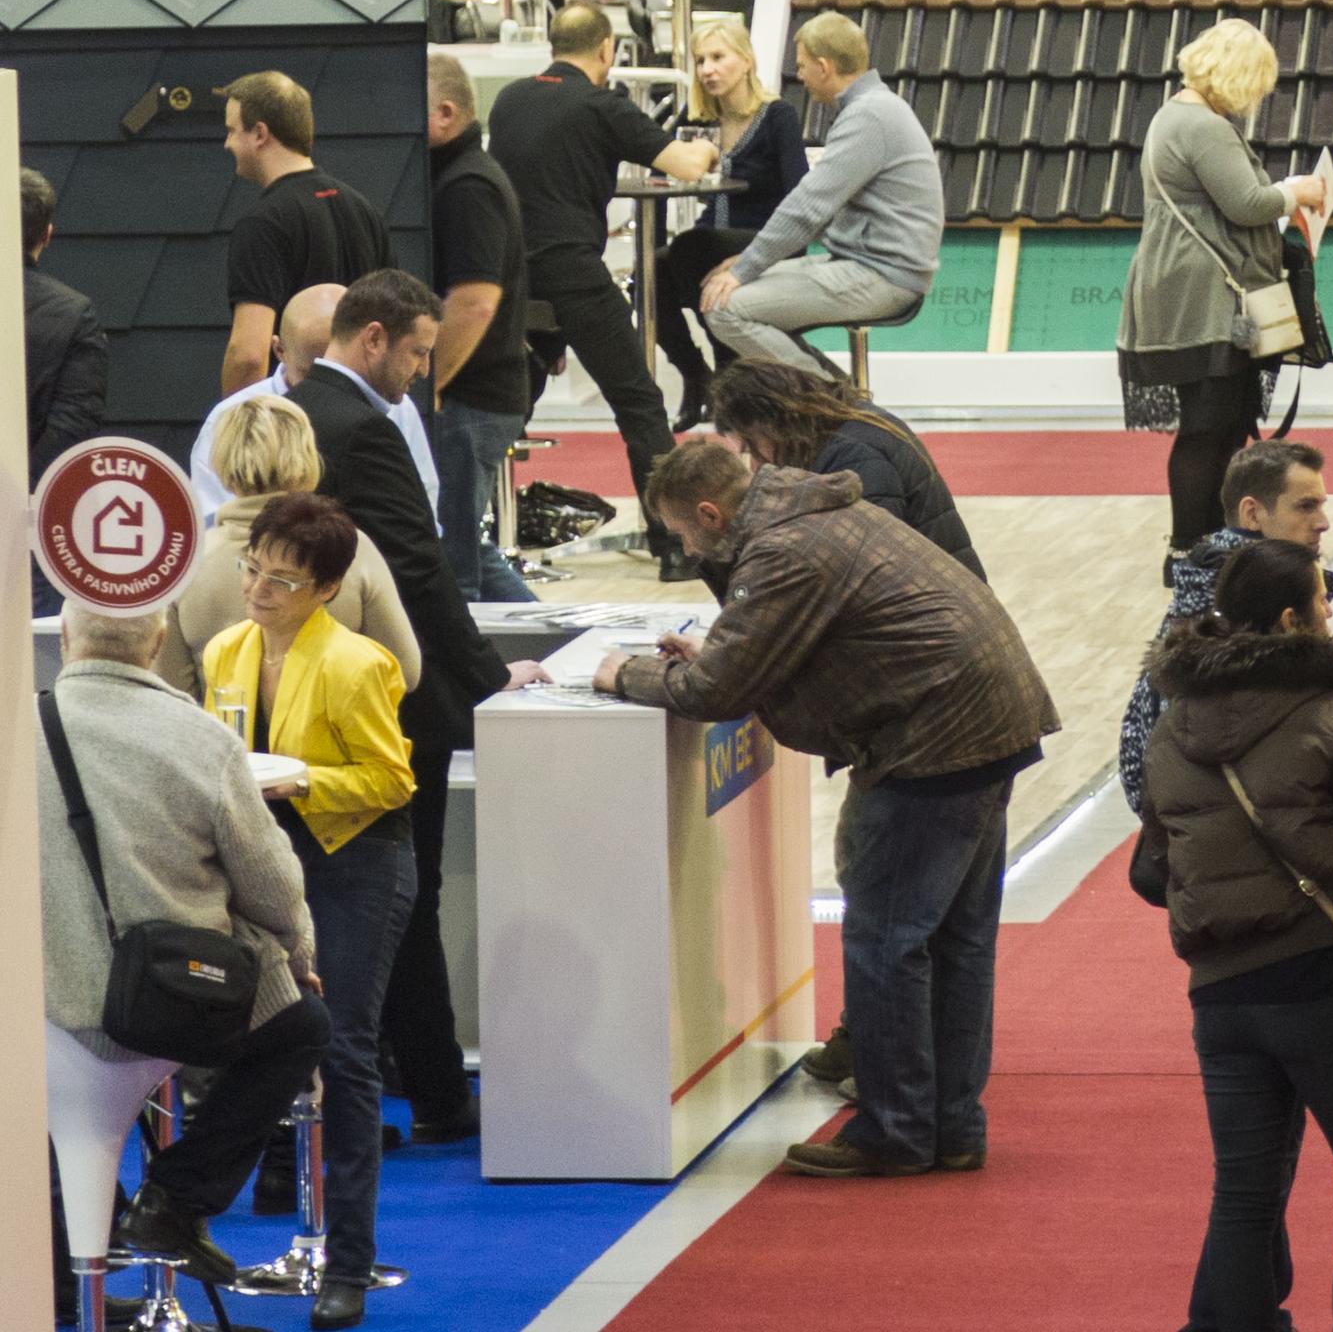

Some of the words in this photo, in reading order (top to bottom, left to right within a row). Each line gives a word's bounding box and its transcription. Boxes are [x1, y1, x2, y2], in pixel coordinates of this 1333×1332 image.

[1070, 286, 1124, 305] BRA
[90, 453, 147, 481] ČLEN
[52, 524, 83, 578] CENTRA
[83, 572, 161, 596] PASIVNÍHO
[158, 531, 185, 577] DOMU
